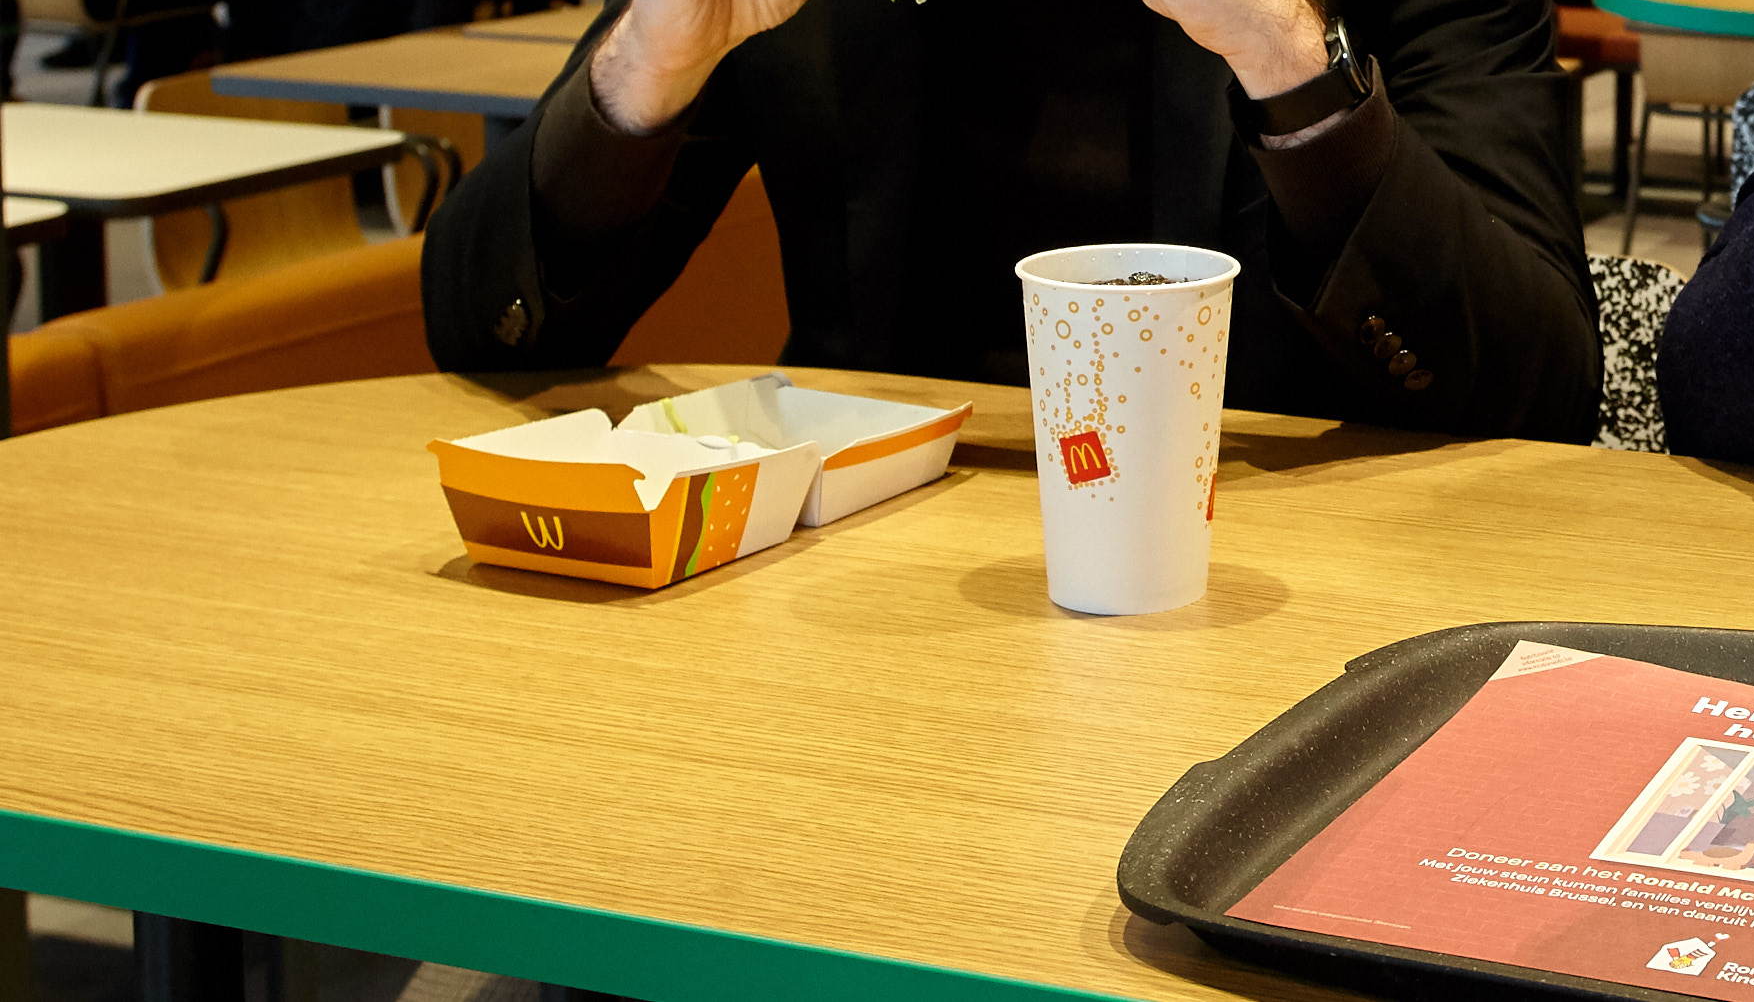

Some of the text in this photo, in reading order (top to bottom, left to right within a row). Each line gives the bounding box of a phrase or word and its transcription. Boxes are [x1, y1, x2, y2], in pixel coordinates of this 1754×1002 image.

[1418, 858, 1453, 870] Met
[1451, 863, 1499, 876] jouw
[1499, 871, 1550, 884] steun
[1552, 877, 1618, 894] kunnen
[1620, 887, 1691, 906] families
[1446, 847, 1533, 867] Doneer
[1534, 860, 1578, 875] aan
[1582, 865, 1623, 881] het
[1626, 872, 1715, 895] Ronald
[1451, 873, 1546, 895] Ziekenhuis
[1548, 888, 1617, 907] Brussel,
[1620, 900, 1644, 910] en
[1648, 905, 1679, 916] van
[1682, 909, 1747, 927] daaruit
